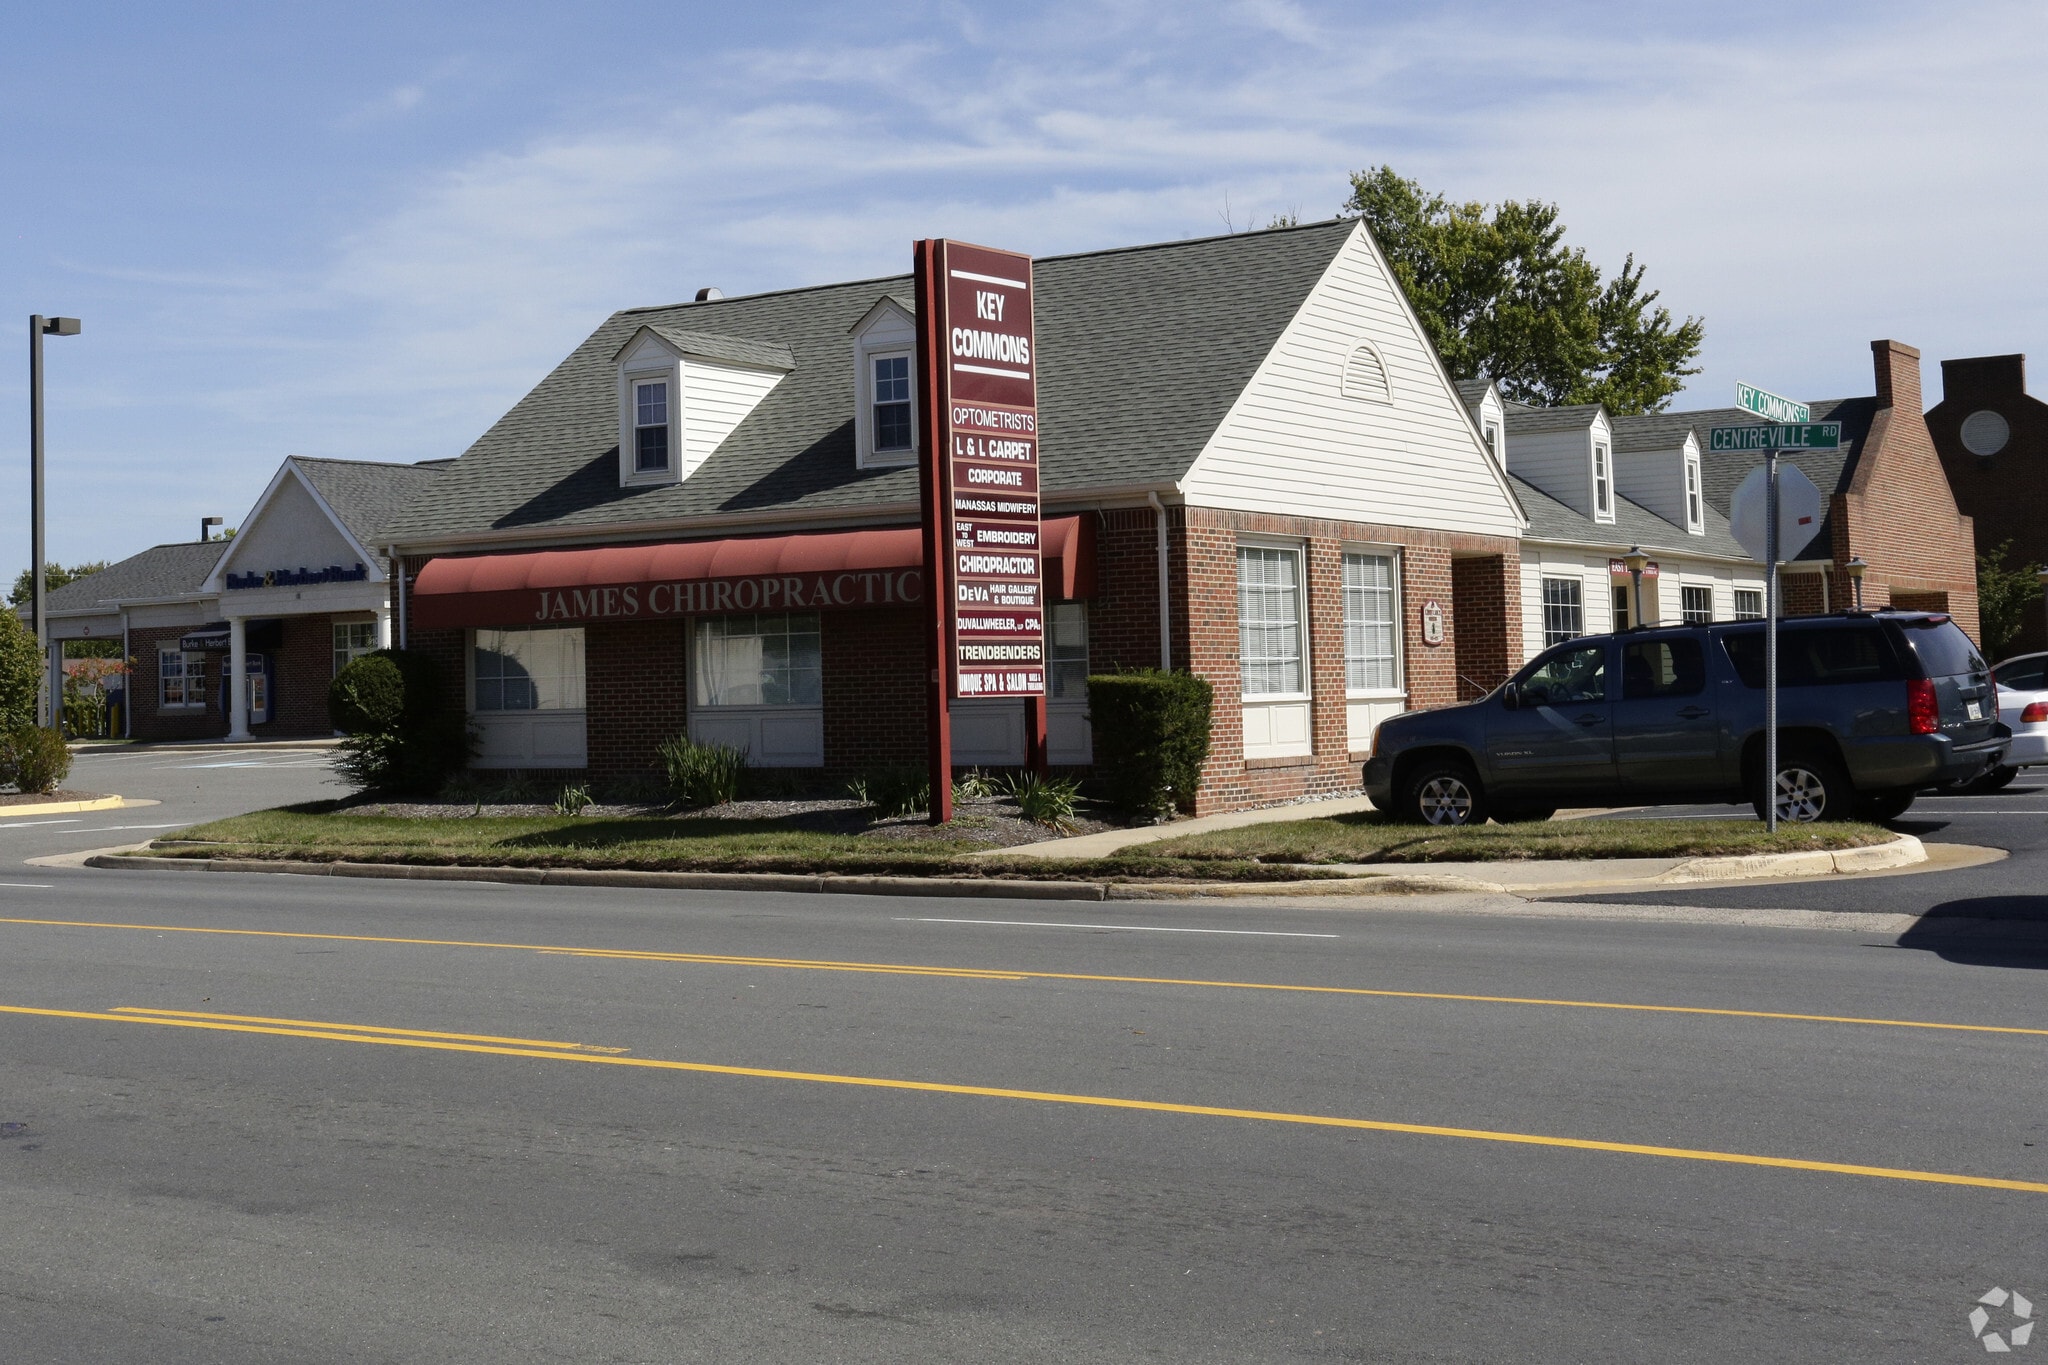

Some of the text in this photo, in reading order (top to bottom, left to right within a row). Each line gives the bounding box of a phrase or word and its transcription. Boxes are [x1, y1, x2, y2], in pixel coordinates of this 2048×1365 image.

[976, 290, 1005, 322] KEY
[952, 327, 1030, 365] COMMONS
[1737, 384, 1808, 422] KEY COMMONS CT
[953, 407, 1035, 431] OPTOMETRISTS
[1713, 425, 1837, 450] CENTREVILLE RD
[956, 436, 1032, 460] L & L CARPET
[968, 468, 1022, 486] CORPORATE
[955, 499, 1036, 514] MANASSAS MIDWIFERY
[956, 522, 972, 531] EAST
[956, 539, 974, 548] WEST
[976, 530, 1036, 545] EMBROIDERY
[959, 555, 1035, 574] CHIROPRACTOR
[263, 570, 275, 588] &
[535, 570, 922, 621] JAMES CHIROPRACTIC
[990, 584, 1037, 595] HAIR GALLERY
[994, 596, 1034, 605] & BOUTIQUE
[957, 617, 1017, 631] DUVALLWHEELER,
[182, 639, 199, 648] Burke
[959, 645, 1041, 660] TRENDBENDERS
[959, 673, 1026, 695] UNIQUE SPA & SALON
